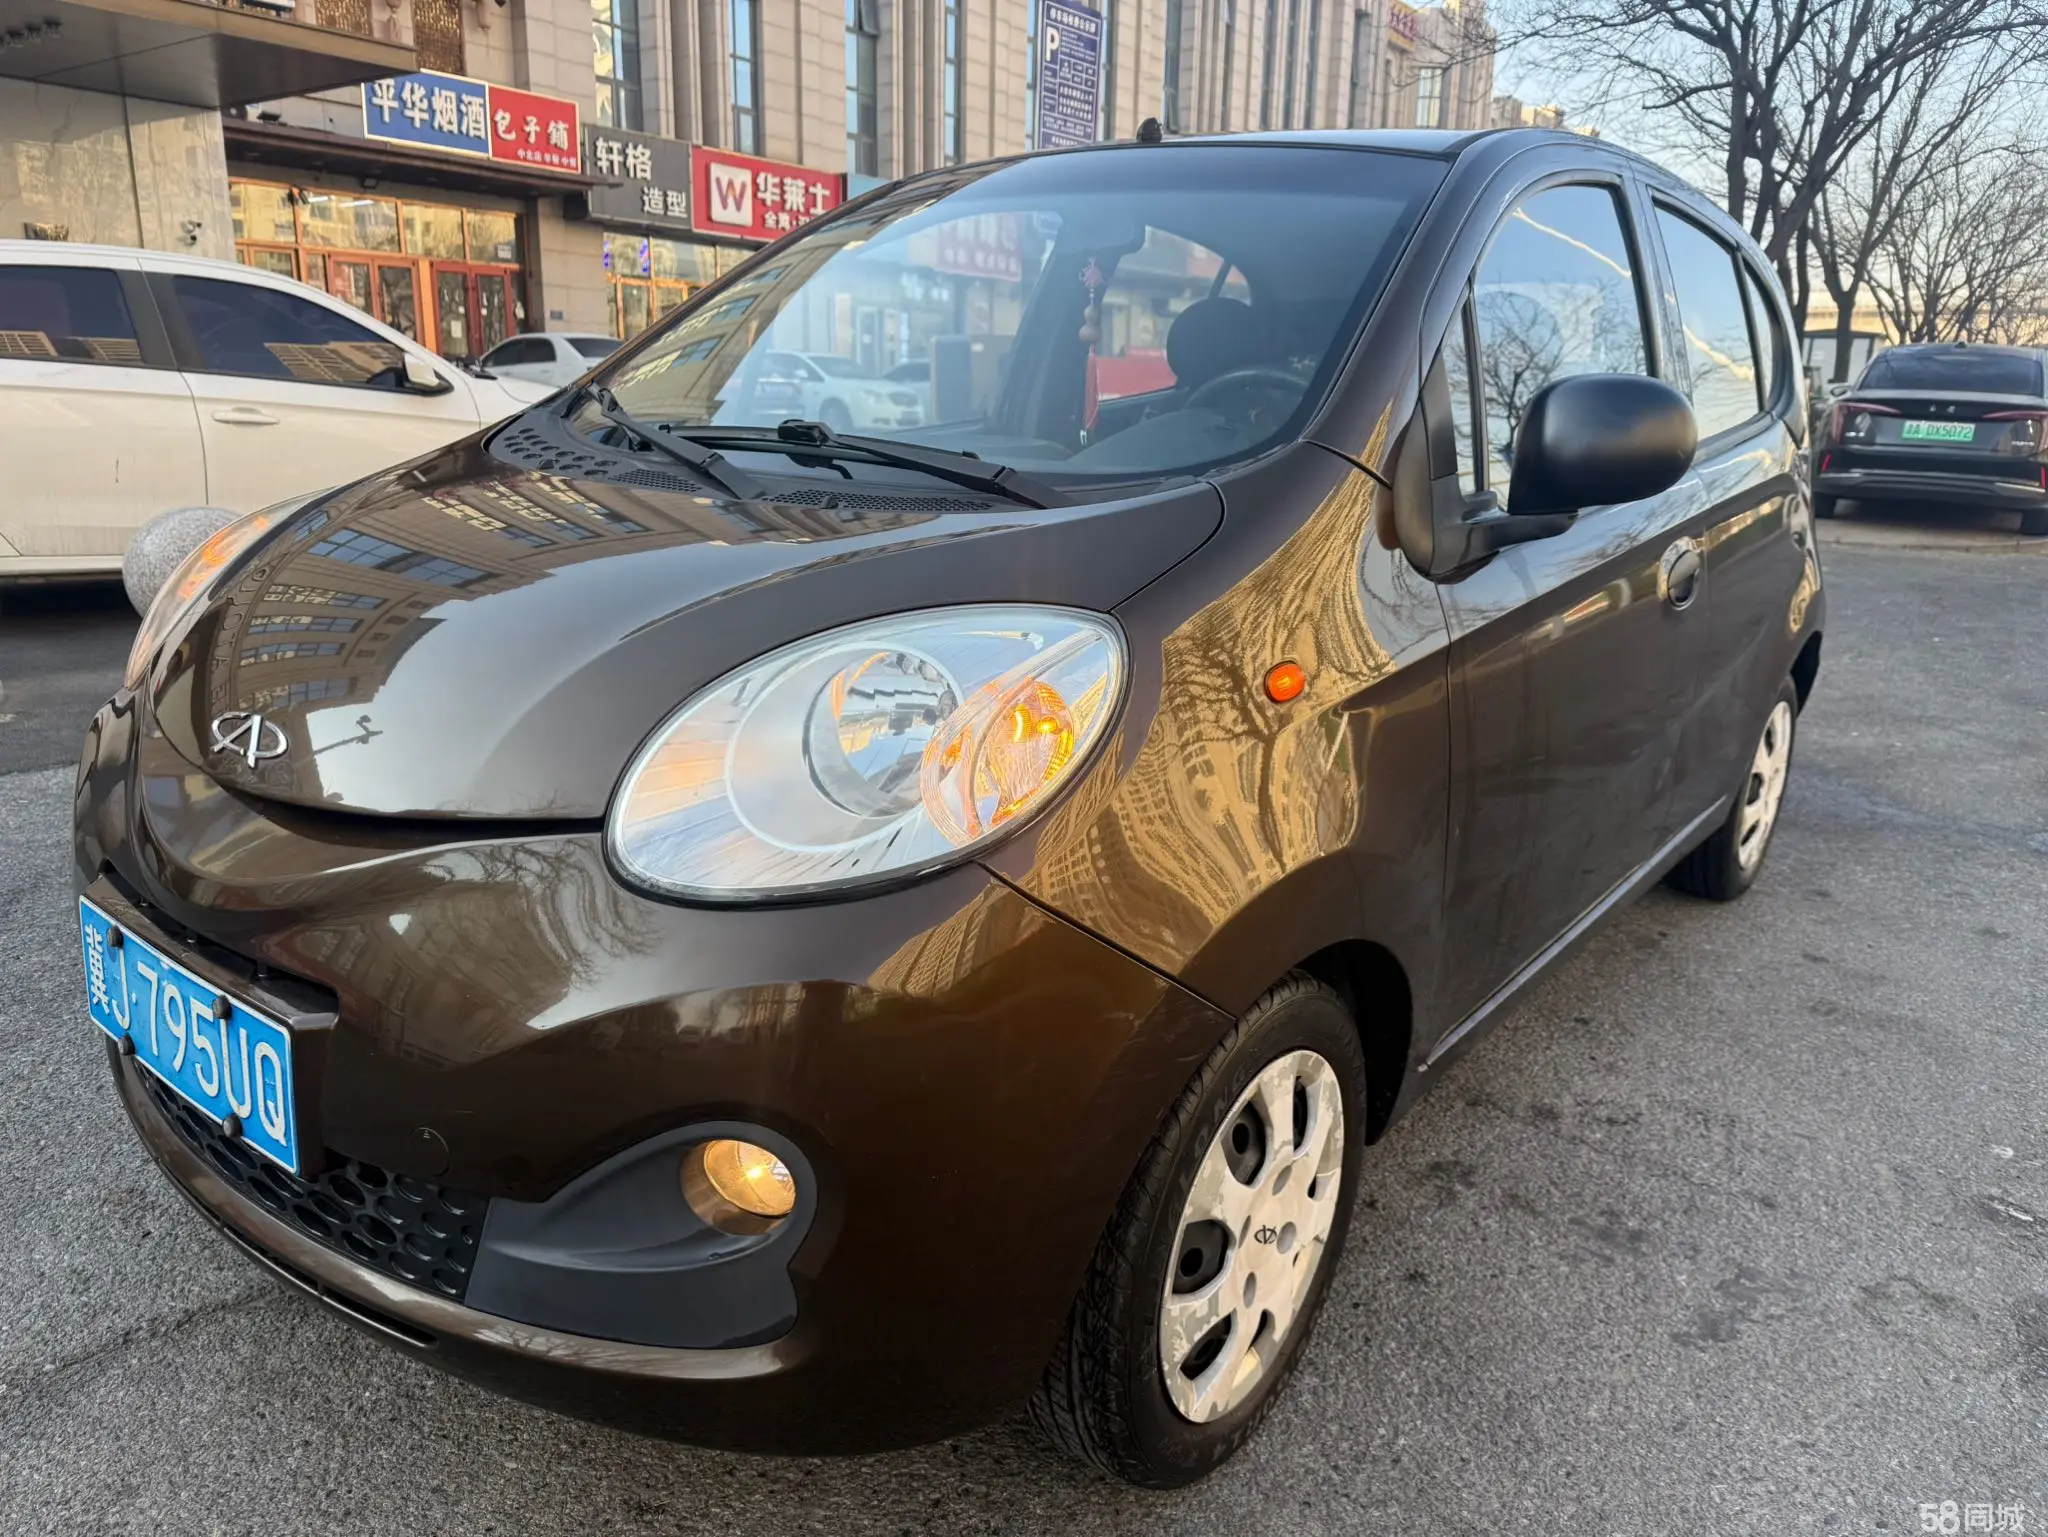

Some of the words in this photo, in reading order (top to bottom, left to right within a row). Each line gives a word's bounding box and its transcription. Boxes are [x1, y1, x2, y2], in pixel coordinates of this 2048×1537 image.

[1046, 26, 1060, 61] P
[371, 78, 486, 140] 平华烟酒
[493, 108, 569, 150] 包子铺
[595, 137, 652, 181] 轩格
[642, 186, 688, 219] 造型
[756, 172, 831, 217] 华莱士
